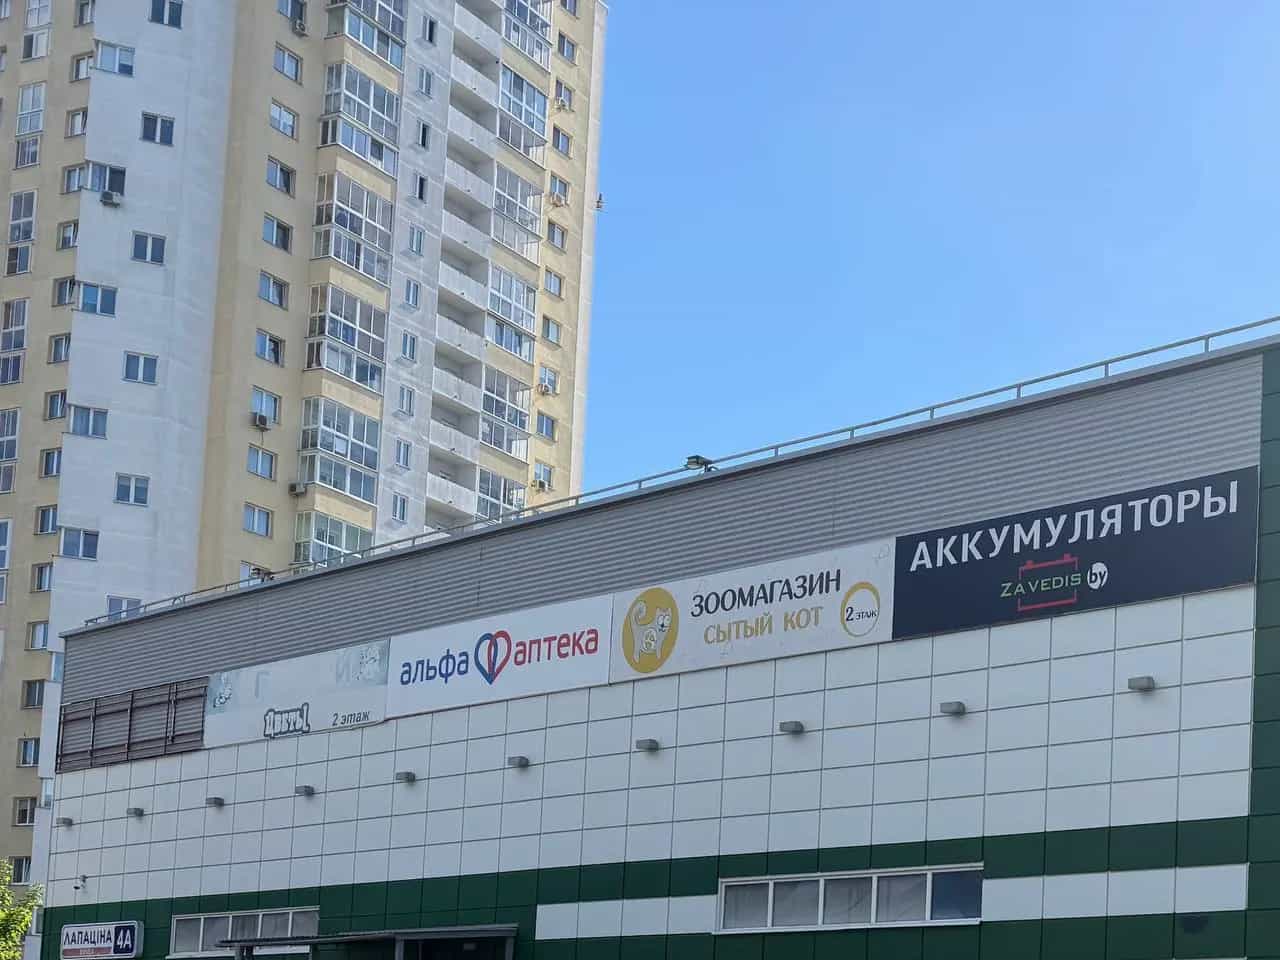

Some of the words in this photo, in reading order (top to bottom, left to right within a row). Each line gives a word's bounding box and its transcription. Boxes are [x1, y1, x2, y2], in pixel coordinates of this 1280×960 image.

[909, 480, 1239, 572] АККУМУЛЯТОРЫ
[691, 569, 841, 617] ЗООМАГАЗИН
[1000, 573, 1081, 598] ZAVEDIS
[1088, 567, 1107, 588] by
[704, 611, 773, 645] СЫТЫЙ
[784, 606, 824, 632] КОТ
[846, 606, 854, 621] 2
[400, 648, 469, 686] альфа
[514, 627, 599, 666] аптека
[332, 713, 339, 726] 2
[341, 711, 370, 725] этаж
[117, 929, 132, 949] 4А
